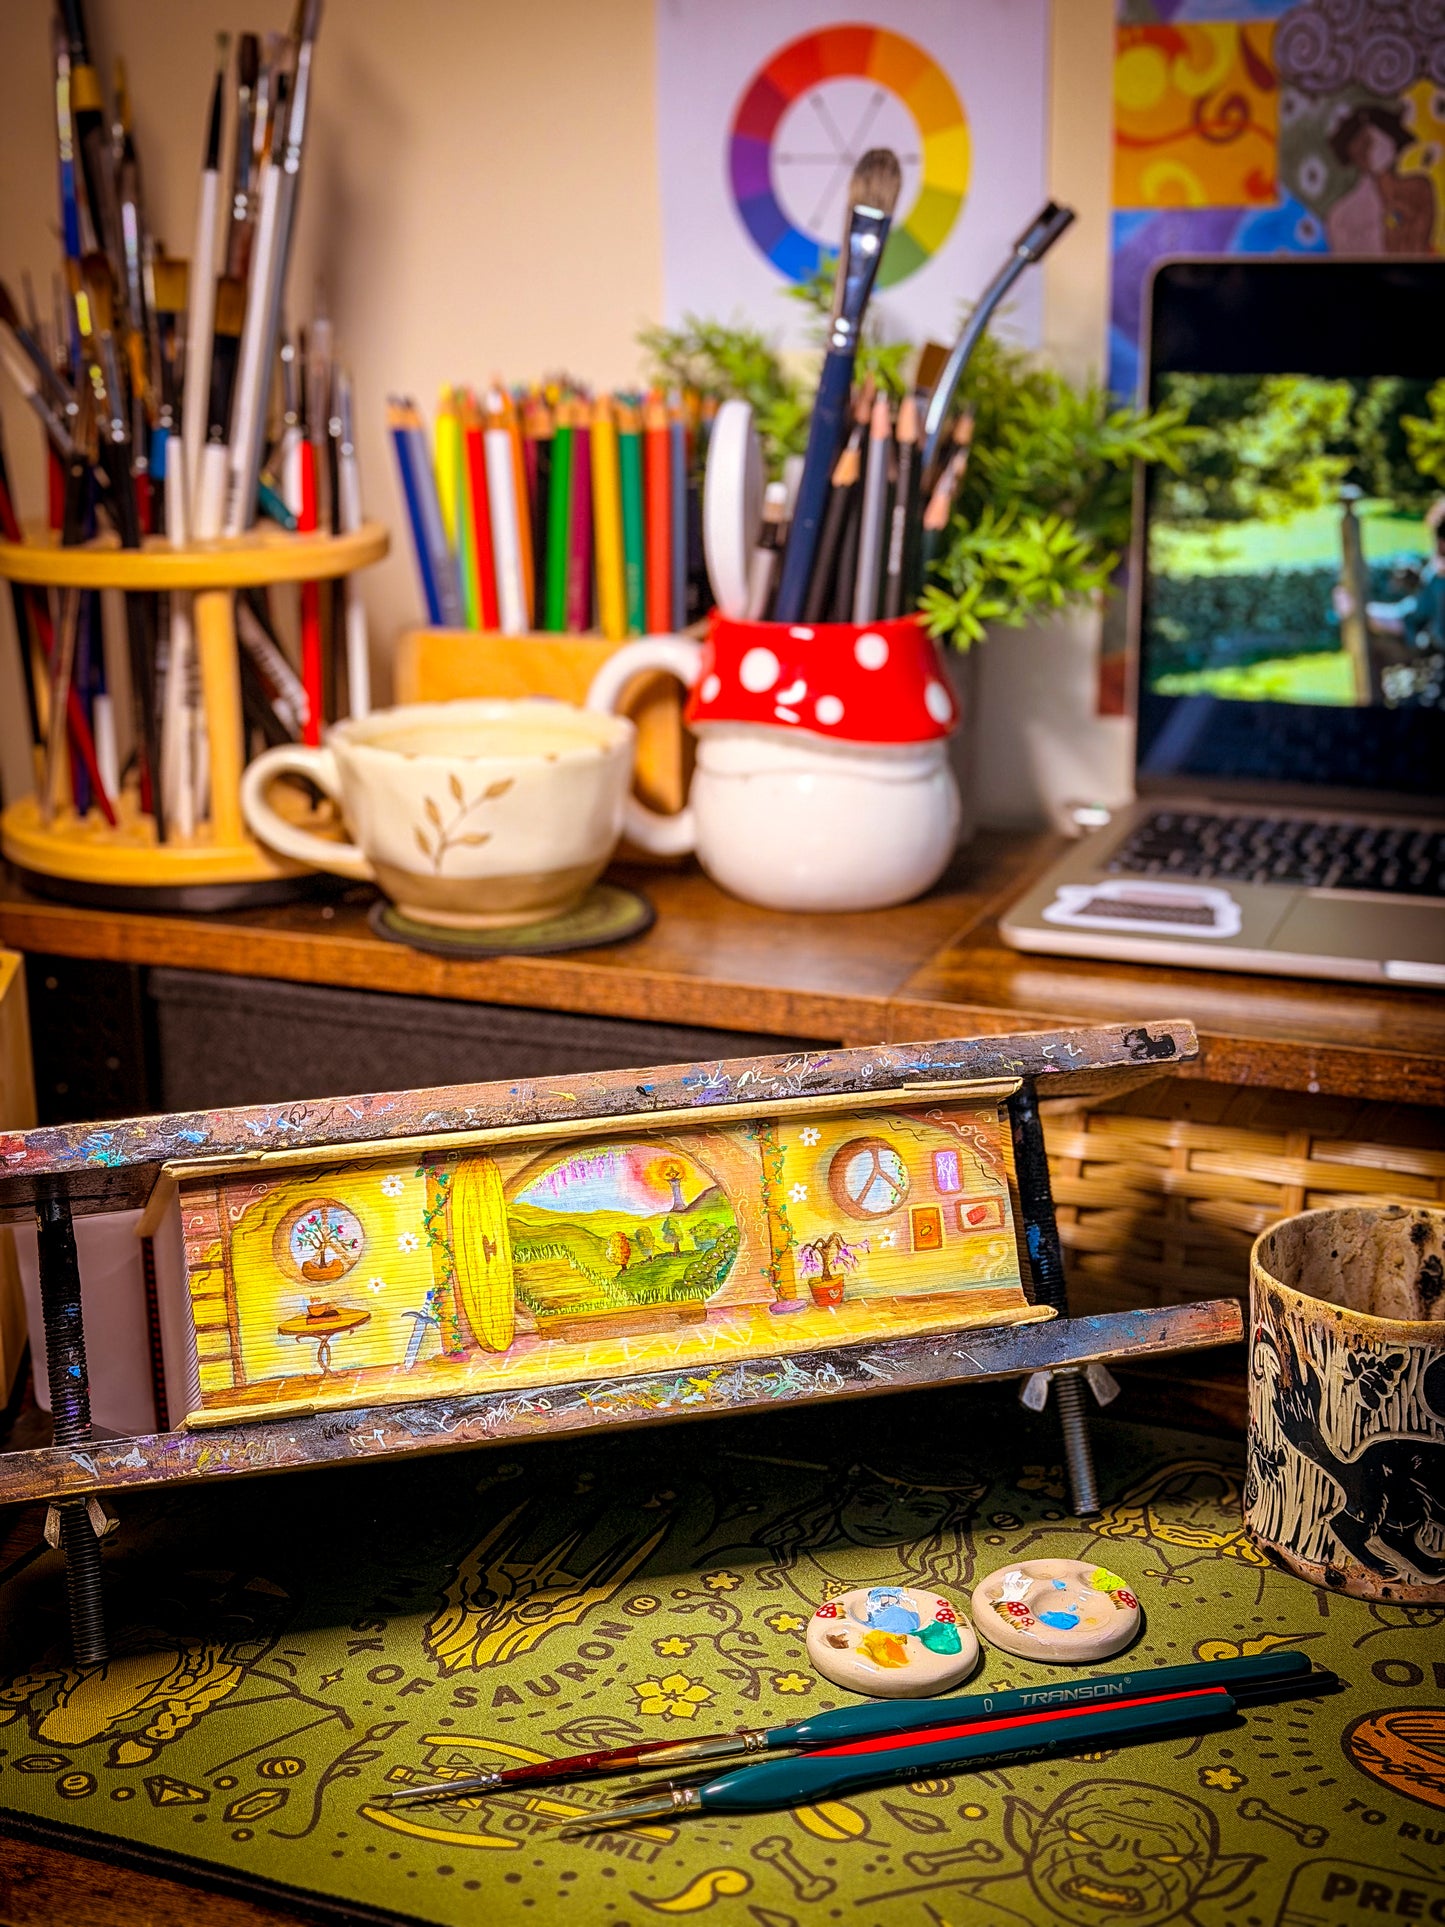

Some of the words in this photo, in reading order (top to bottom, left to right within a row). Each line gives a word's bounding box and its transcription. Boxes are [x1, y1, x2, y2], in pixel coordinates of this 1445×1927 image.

[366, 1663, 436, 1698] OF
[449, 1619, 635, 1708] SAURON
[536, 1784, 623, 1809] ATTL
[1342, 1798, 1388, 1826] TO
